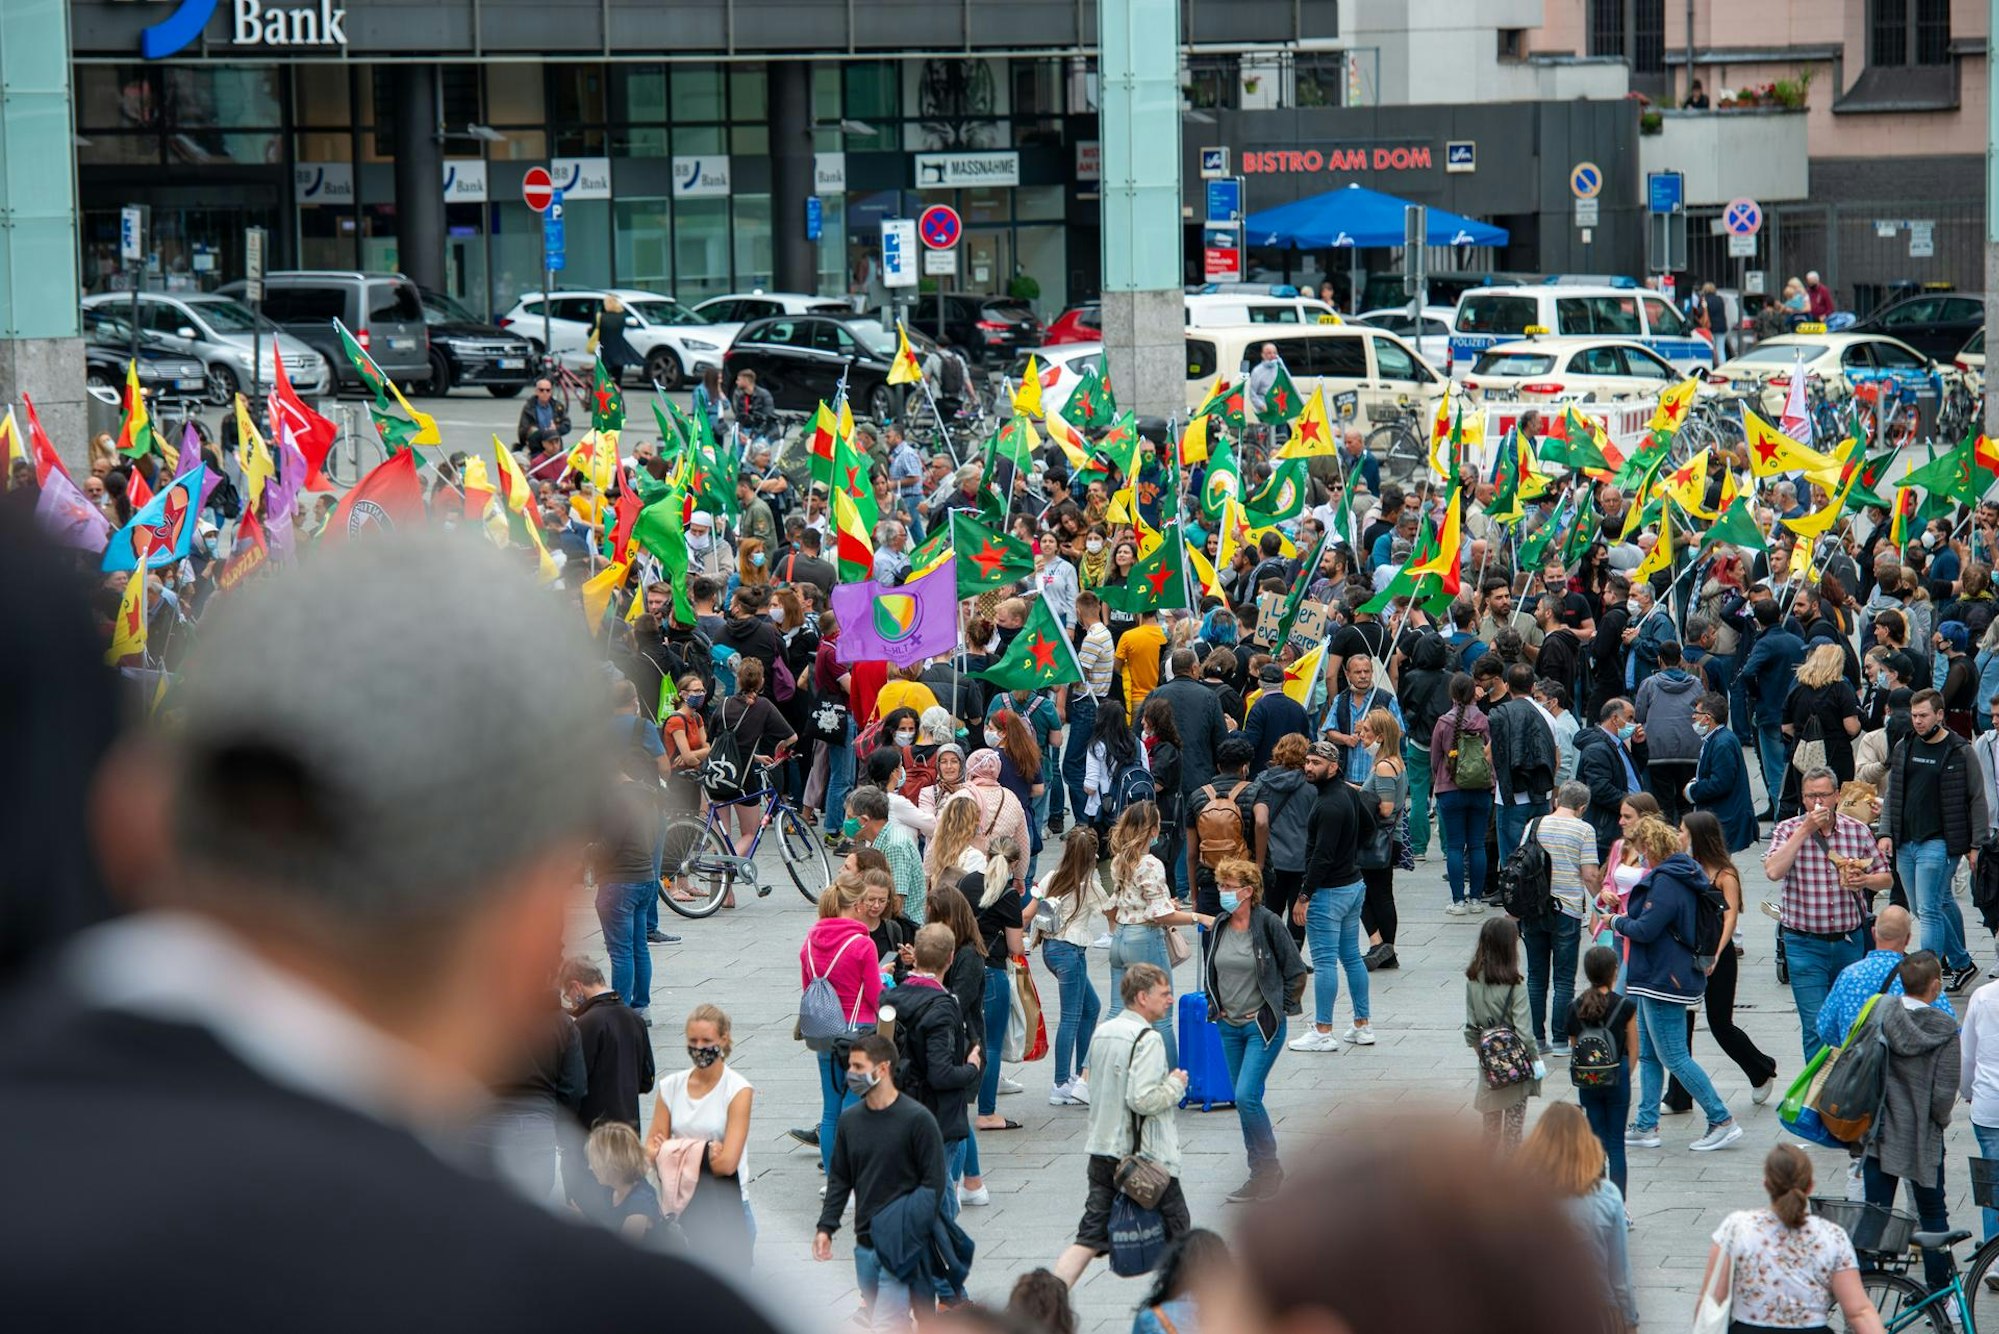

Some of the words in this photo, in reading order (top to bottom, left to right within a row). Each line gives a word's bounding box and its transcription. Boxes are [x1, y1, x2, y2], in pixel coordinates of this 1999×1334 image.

[233, 0, 347, 44] Bank
[951, 159, 1015, 176] MASSNAHME
[1242, 150, 1323, 173] BISTRO
[1329, 150, 1367, 171] AM
[1373, 147, 1432, 169] DOM
[553, 168, 569, 180] BB
[581, 177, 608, 190] Bank
[701, 173, 727, 186] Bank
[817, 170, 843, 183] Bank
[324, 182, 351, 195] Bank
[456, 178, 484, 193] Bank
[1453, 337, 1485, 347] POLIZEI
[1272, 598, 1316, 627] Ler
